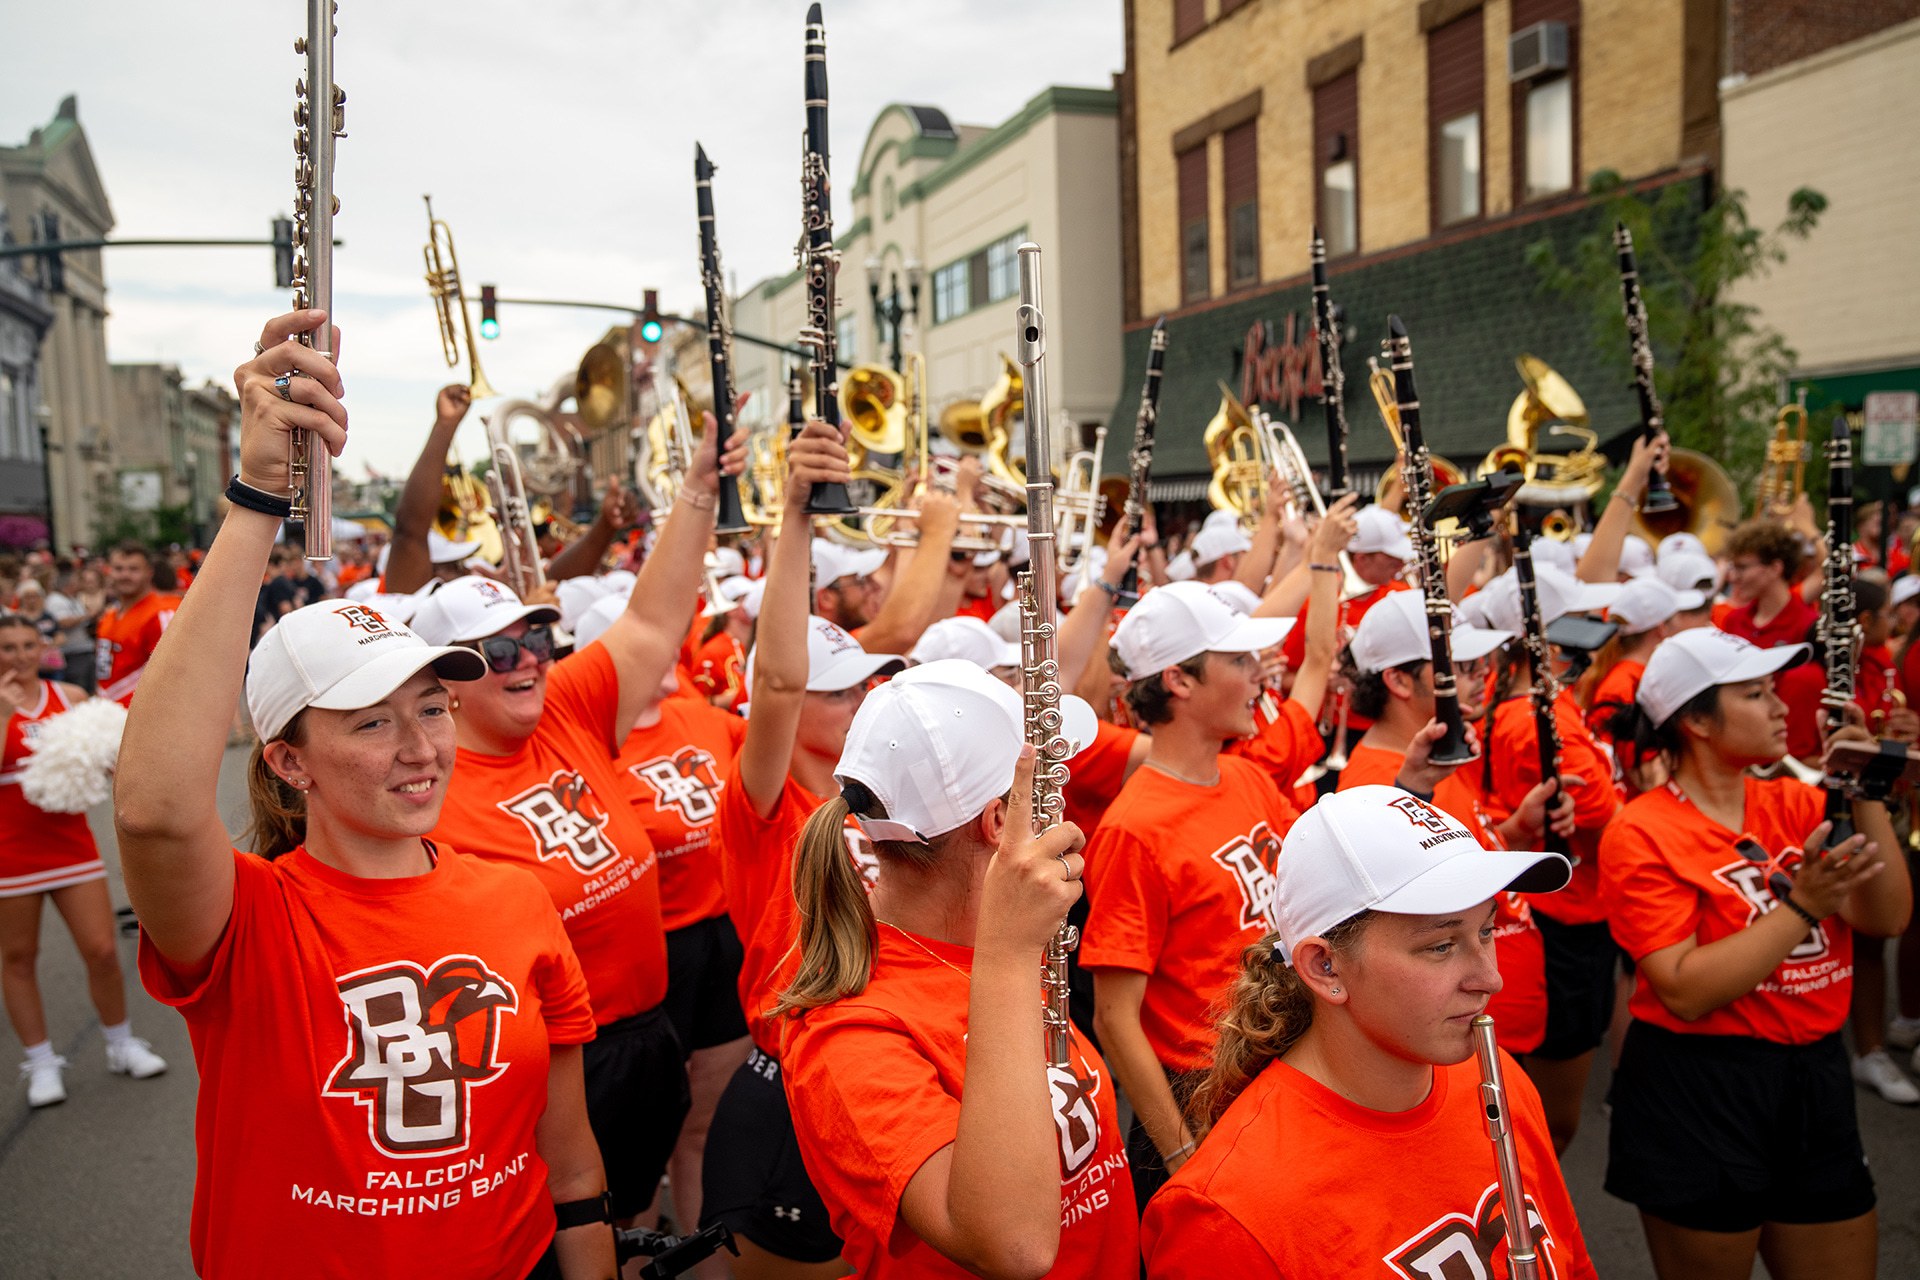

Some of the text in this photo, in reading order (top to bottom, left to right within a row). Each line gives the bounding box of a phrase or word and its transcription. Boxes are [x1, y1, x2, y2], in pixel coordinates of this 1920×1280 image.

[506, 787, 615, 870] BG
[557, 851, 657, 921] ARCHING BAN
[583, 855, 636, 895] FALCON
[1755, 976, 1830, 996] ARCHING
[335, 966, 464, 1152] BG
[366, 1153, 485, 1190] FALCON
[291, 1183, 461, 1217] MARCHING
